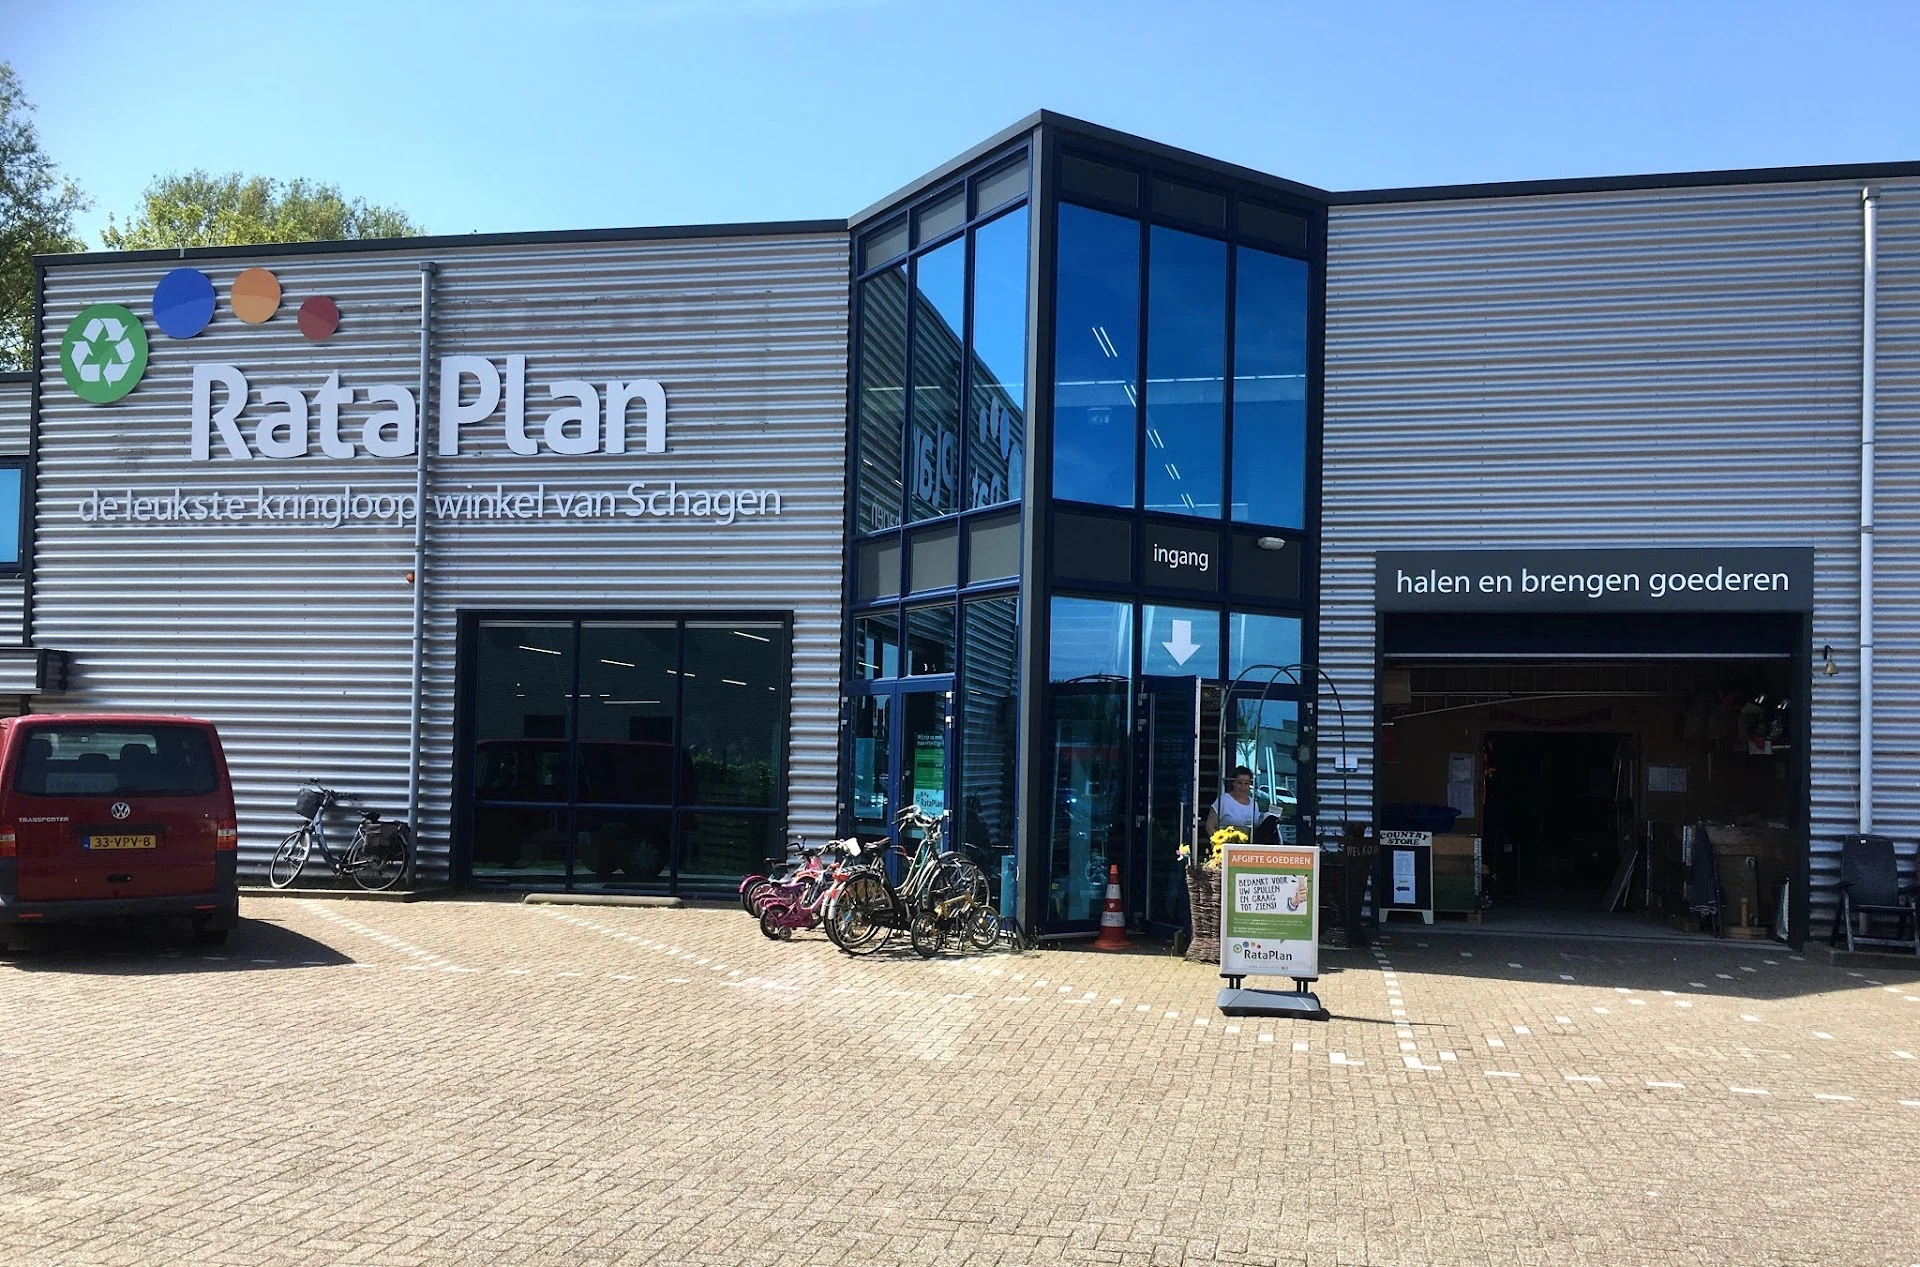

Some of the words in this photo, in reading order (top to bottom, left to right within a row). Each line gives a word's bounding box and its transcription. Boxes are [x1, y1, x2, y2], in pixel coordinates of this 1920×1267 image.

[191, 354, 667, 460] RataPlan
[79, 488, 118, 522] de
[126, 486, 245, 522] leukste
[257, 485, 417, 528] kringloop
[434, 483, 545, 519] winkel
[555, 488, 616, 518] van
[624, 481, 782, 525] Schagen
[1153, 543, 1209, 571] ingang
[1397, 569, 1470, 593] halen
[1478, 575, 1512, 593] en
[1521, 568, 1640, 598] brengen
[1649, 566, 1789, 598] goederen
[1380, 831, 1430, 840] COUNTRY
[94, 837, 151, 847] 33-VPV-8
[1231, 854, 1265, 863] AFGIFTE
[1266, 856, 1311, 865] GOEDEREN
[1238, 877, 1269, 887] BEDANKT
[1271, 876, 1288, 884] VOOR
[1239, 887, 1251, 895] UW
[1253, 885, 1280, 894] SPULLEN
[1240, 895, 1249, 904] EN
[1252, 894, 1276, 903] GRAAG
[1240, 904, 1252, 912] TOT
[1255, 902, 1277, 911] ZIENS!
[1244, 949, 1293, 961] RataPlan
